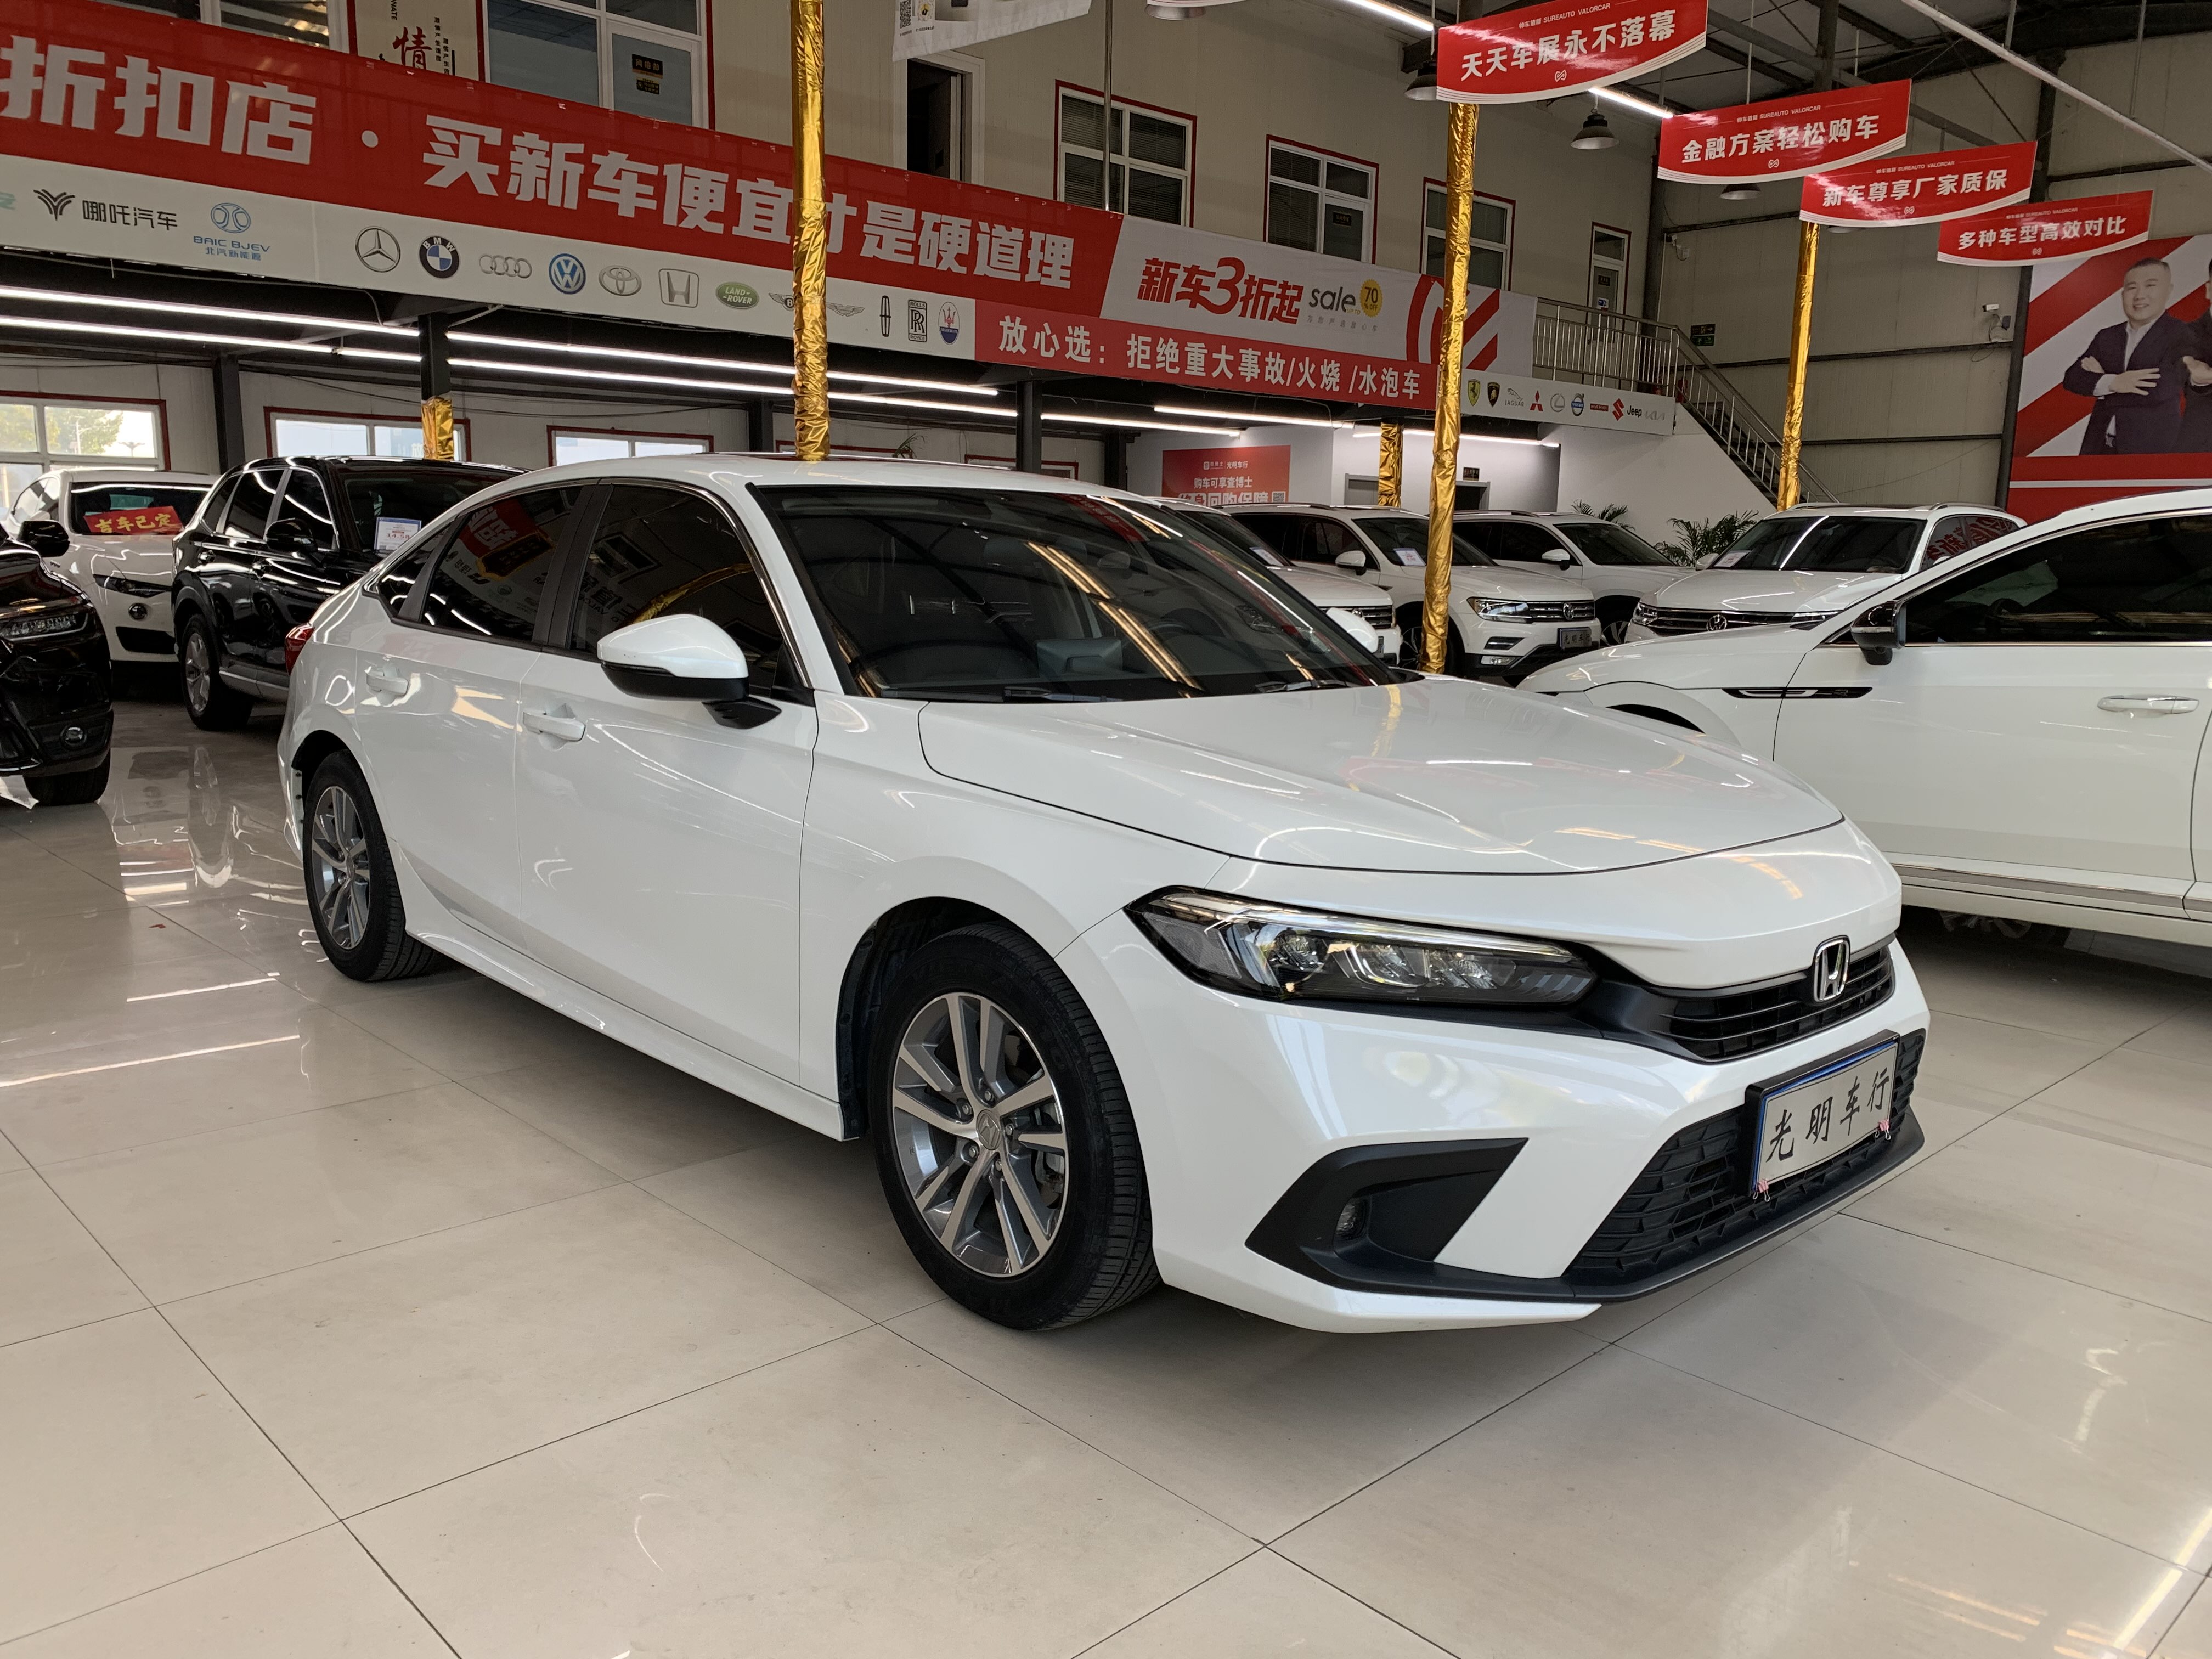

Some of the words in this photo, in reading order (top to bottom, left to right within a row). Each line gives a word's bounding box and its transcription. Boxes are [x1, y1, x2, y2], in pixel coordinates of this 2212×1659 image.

[1543, 11, 1576, 23] SUREAUTO
[1578, 3, 1611, 15] VALORCAR
[392, 26, 432, 69] 情
[1461, 9, 1676, 81] 天天车展永不落幕
[1759, 110, 1789, 119] SUREAUTO
[1791, 105, 1821, 114] VALORCAR
[1681, 114, 1880, 163] 金融方案轻松购车
[1822, 169, 2007, 207] 新车尊享厂家质保
[82, 200, 178, 231] 哪吒汽车
[193, 235, 226, 248] BAIC
[231, 240, 271, 253] BJEV
[1958, 215, 2127, 250] 多种车型高效对比
[205, 247, 262, 261] 北汽新能源
[422, 236, 456, 253] BMW
[1137, 256, 1304, 325] 新车3折起
[1308, 286, 1356, 313] sale
[1364, 286, 1379, 304] 70
[1627, 405, 1642, 418] Jeep
[1226, 461, 1248, 469] 光明车行
[1194, 476, 1253, 489] 购车可享查博士
[1766, 1067, 1889, 1162] 光明车行
